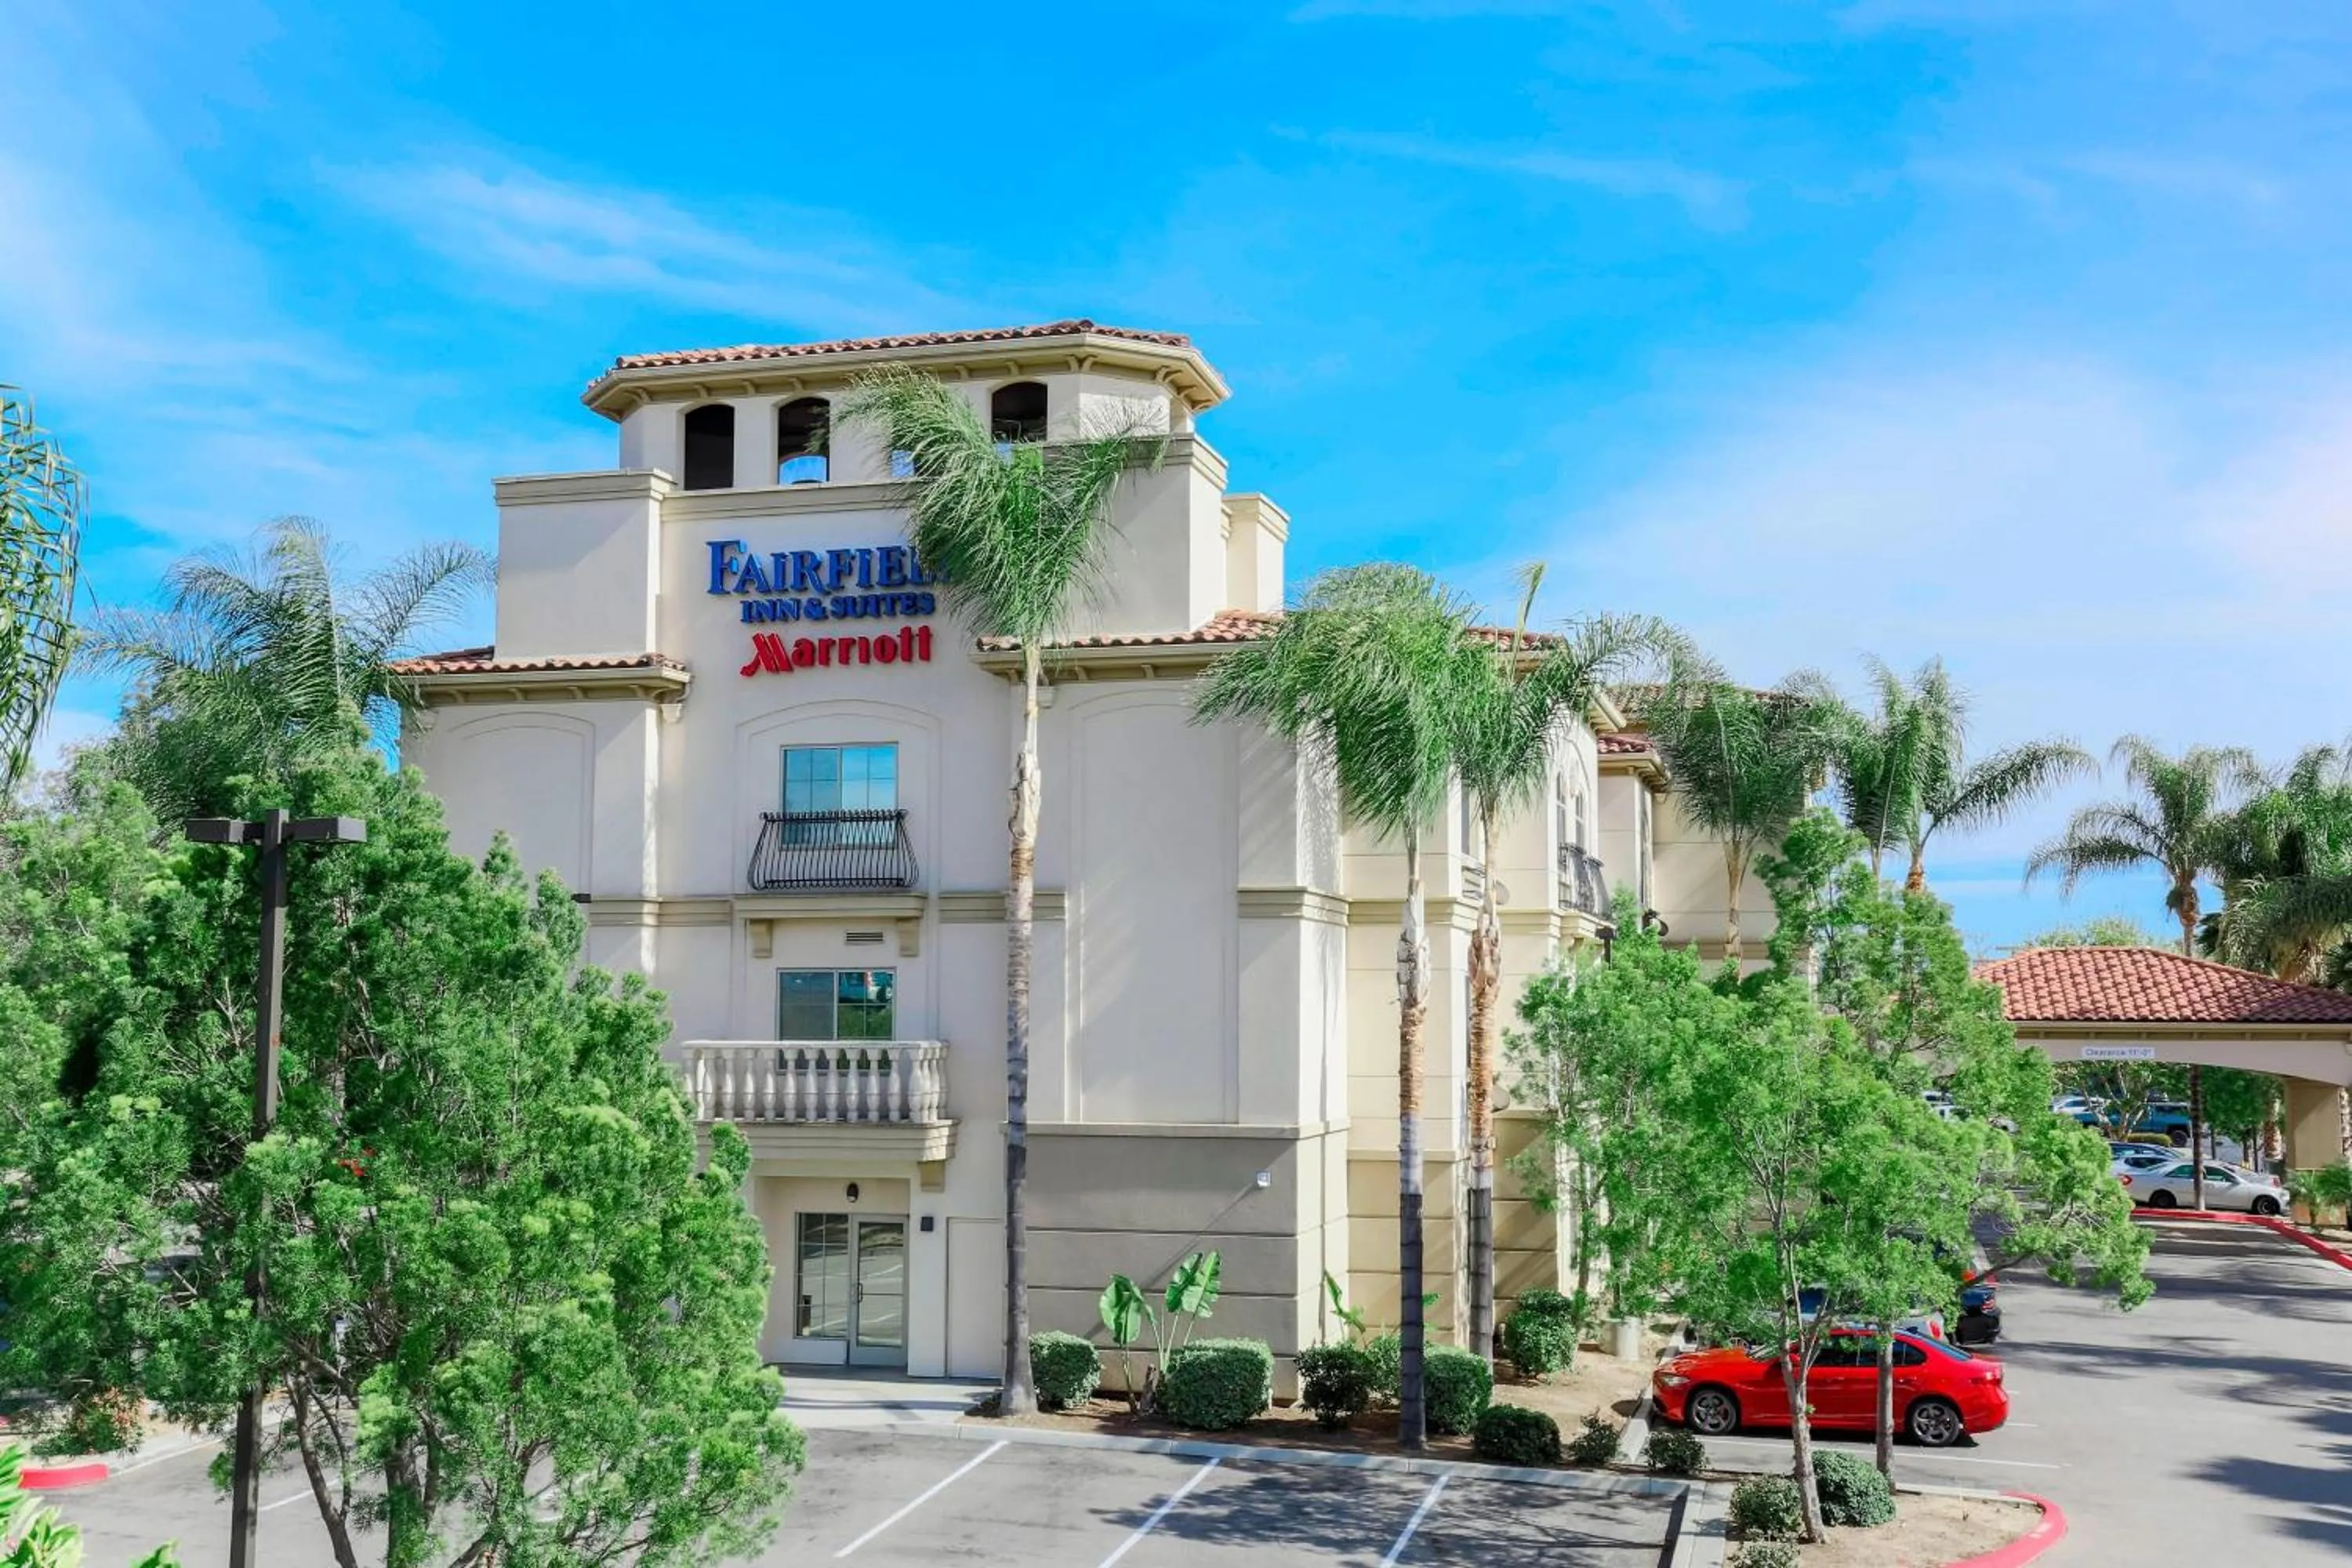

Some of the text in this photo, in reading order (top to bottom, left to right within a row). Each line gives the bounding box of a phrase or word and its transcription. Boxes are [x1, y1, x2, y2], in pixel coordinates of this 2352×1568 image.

[706, 539, 951, 593] FAIRFIEL
[740, 600, 800, 622] INN
[830, 592, 935, 618] SUITES
[740, 626, 932, 677] Marriott
